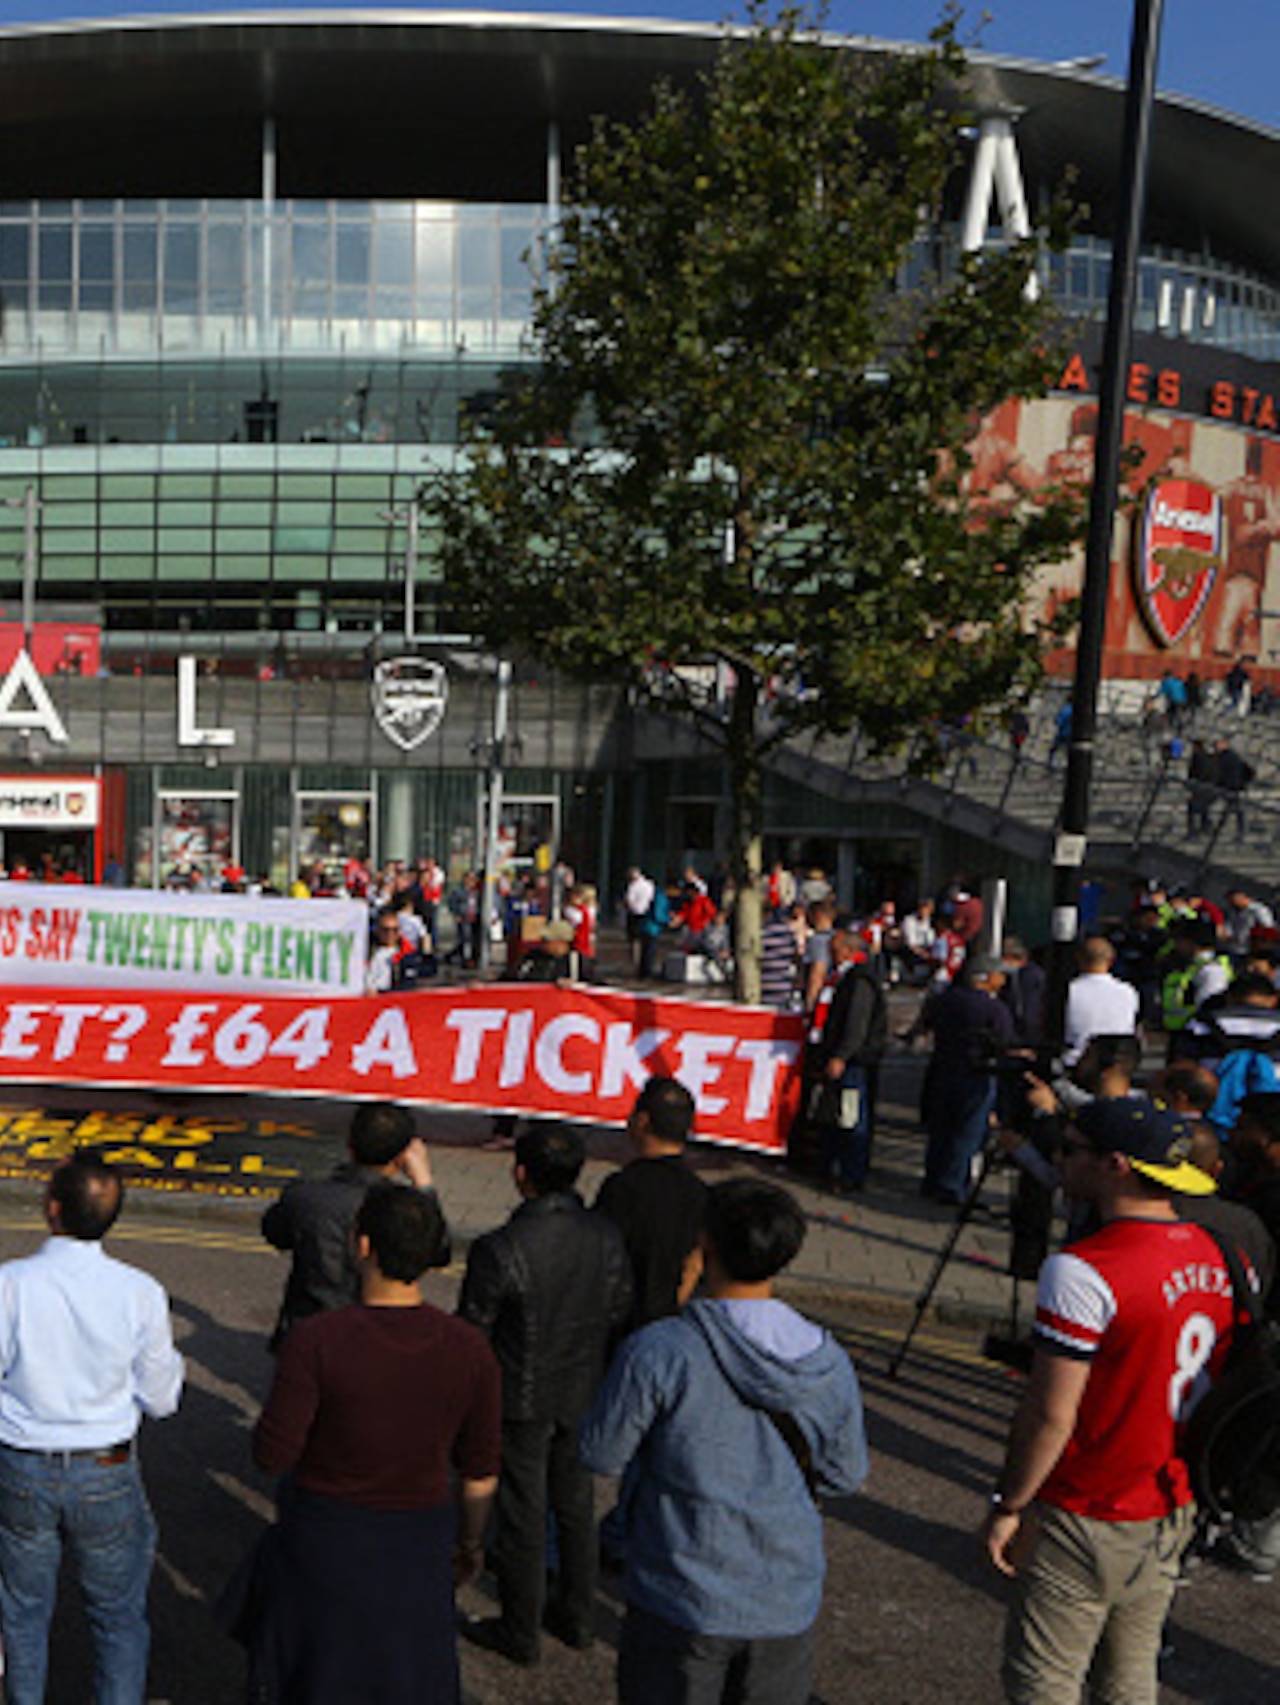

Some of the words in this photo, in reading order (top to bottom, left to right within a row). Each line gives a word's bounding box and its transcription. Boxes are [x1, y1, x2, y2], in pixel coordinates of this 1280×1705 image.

[24, 907, 81, 962] SAY
[86, 909, 233, 976] TWENTY'S
[242, 923, 356, 985] PLENTY
[160, 1003, 332, 1071] £64
[350, 1005, 418, 1080] A
[444, 1007, 803, 1122] TICKET
[1169, 1312, 1217, 1422] 8
